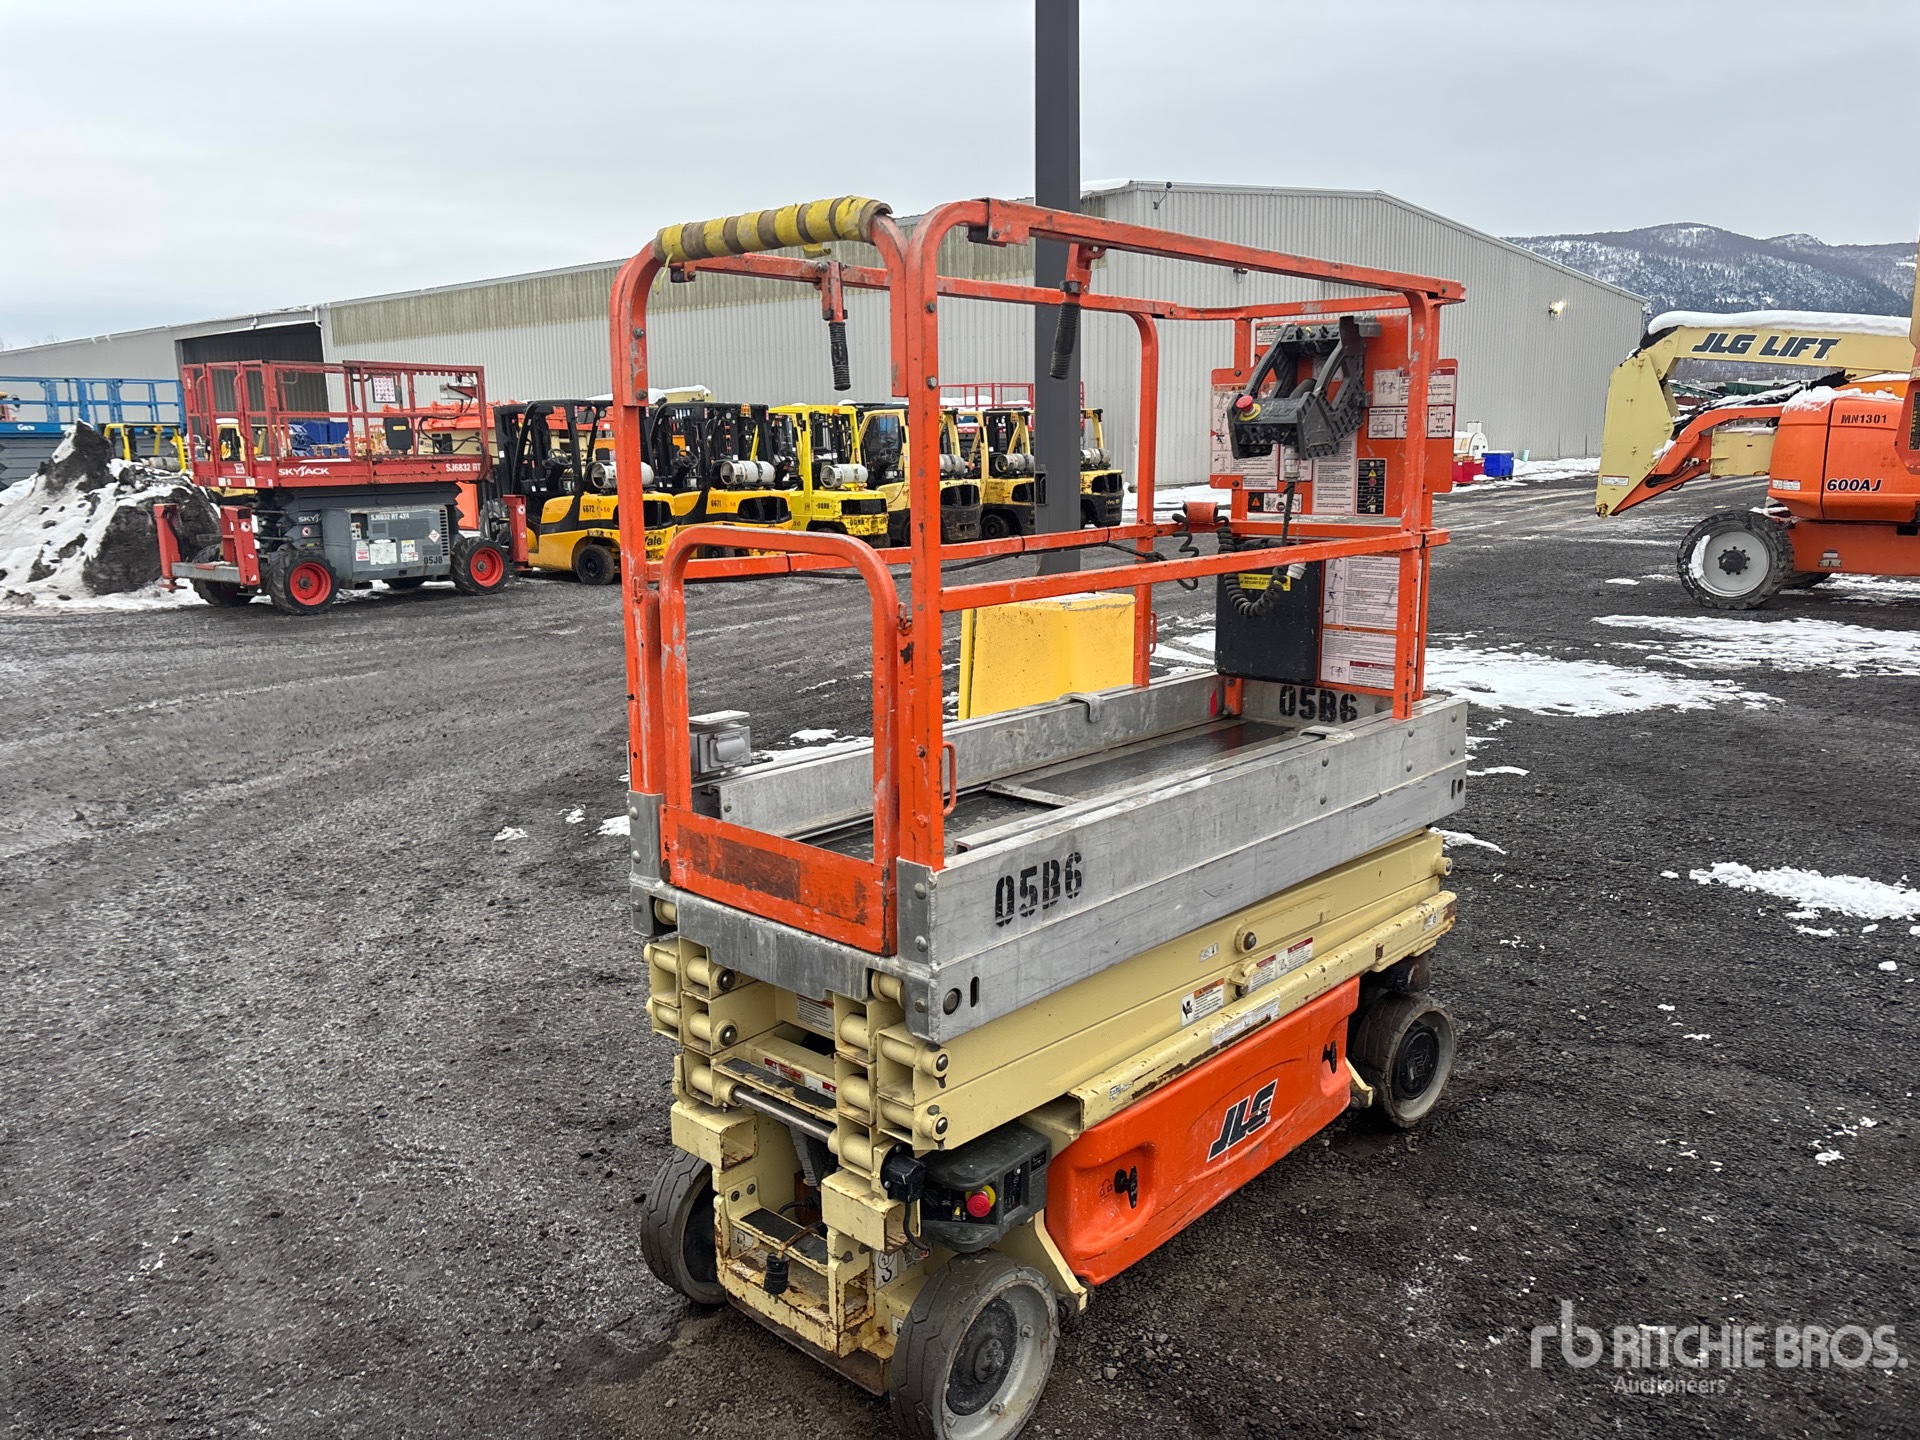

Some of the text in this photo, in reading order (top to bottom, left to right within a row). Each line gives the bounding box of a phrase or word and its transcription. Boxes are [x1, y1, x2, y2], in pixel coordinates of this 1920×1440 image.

[1691, 332, 1842, 360] JLG LIFT
[1840, 414, 1888, 425] MN1301
[278, 464, 330, 476] SKYJACK
[445, 463, 482, 472] SJ6832 RT
[1826, 479, 1883, 492] 600AJ
[298, 513, 321, 523] SKYJ
[423, 555, 444, 566] 05J8
[1279, 684, 1358, 723] 05B6
[995, 851, 1083, 928] 05B6
[1205, 1077, 1279, 1163] JLG
